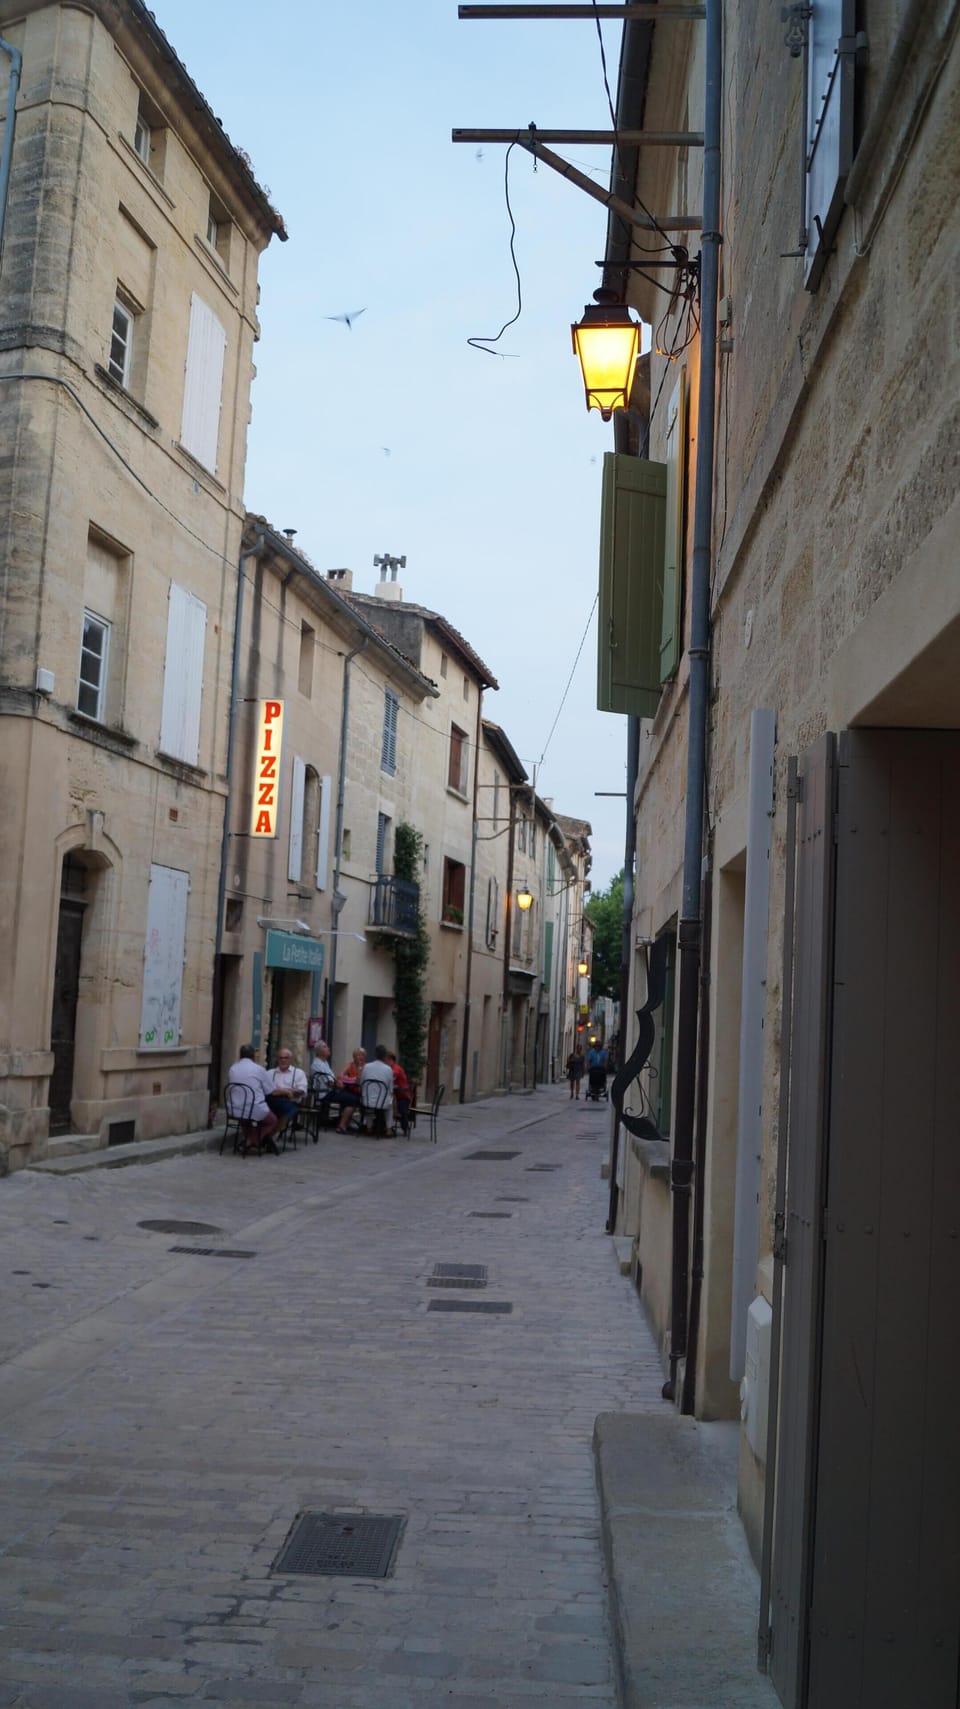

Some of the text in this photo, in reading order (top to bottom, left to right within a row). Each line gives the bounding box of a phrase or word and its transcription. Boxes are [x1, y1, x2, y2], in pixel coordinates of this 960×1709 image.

[255, 701, 281, 833] PIZZA
[282, 943, 290, 962] La
[291, 944, 308, 964] Petite
